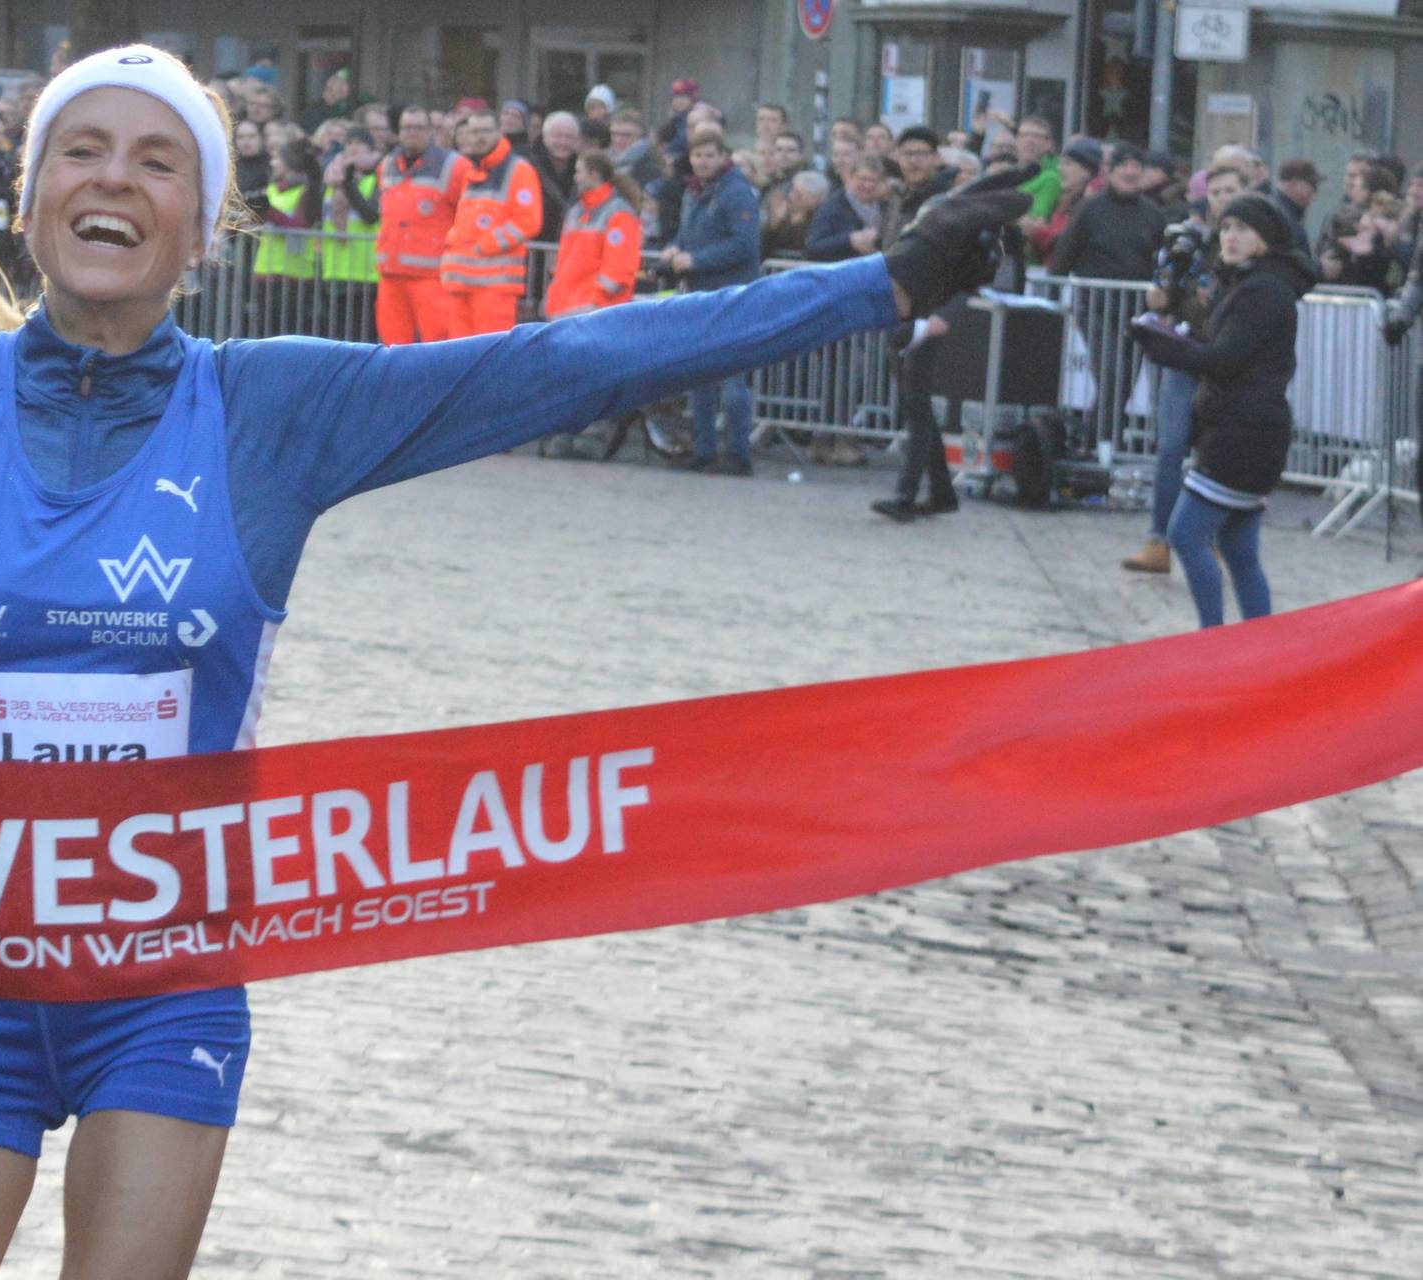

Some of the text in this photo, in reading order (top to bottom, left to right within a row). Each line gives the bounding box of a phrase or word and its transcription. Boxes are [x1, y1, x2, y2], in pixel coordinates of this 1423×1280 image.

[46, 610, 169, 628] STADTWERKE
[91, 630, 168, 646] BOCHUM
[36, 701, 156, 713] SILVESTERLAUF
[10, 712, 39, 722] VON
[2, 732, 147, 763] Laura
[83, 920, 225, 967] WERL
[227, 903, 343, 951] NACH
[350, 880, 496, 931] SOEST
